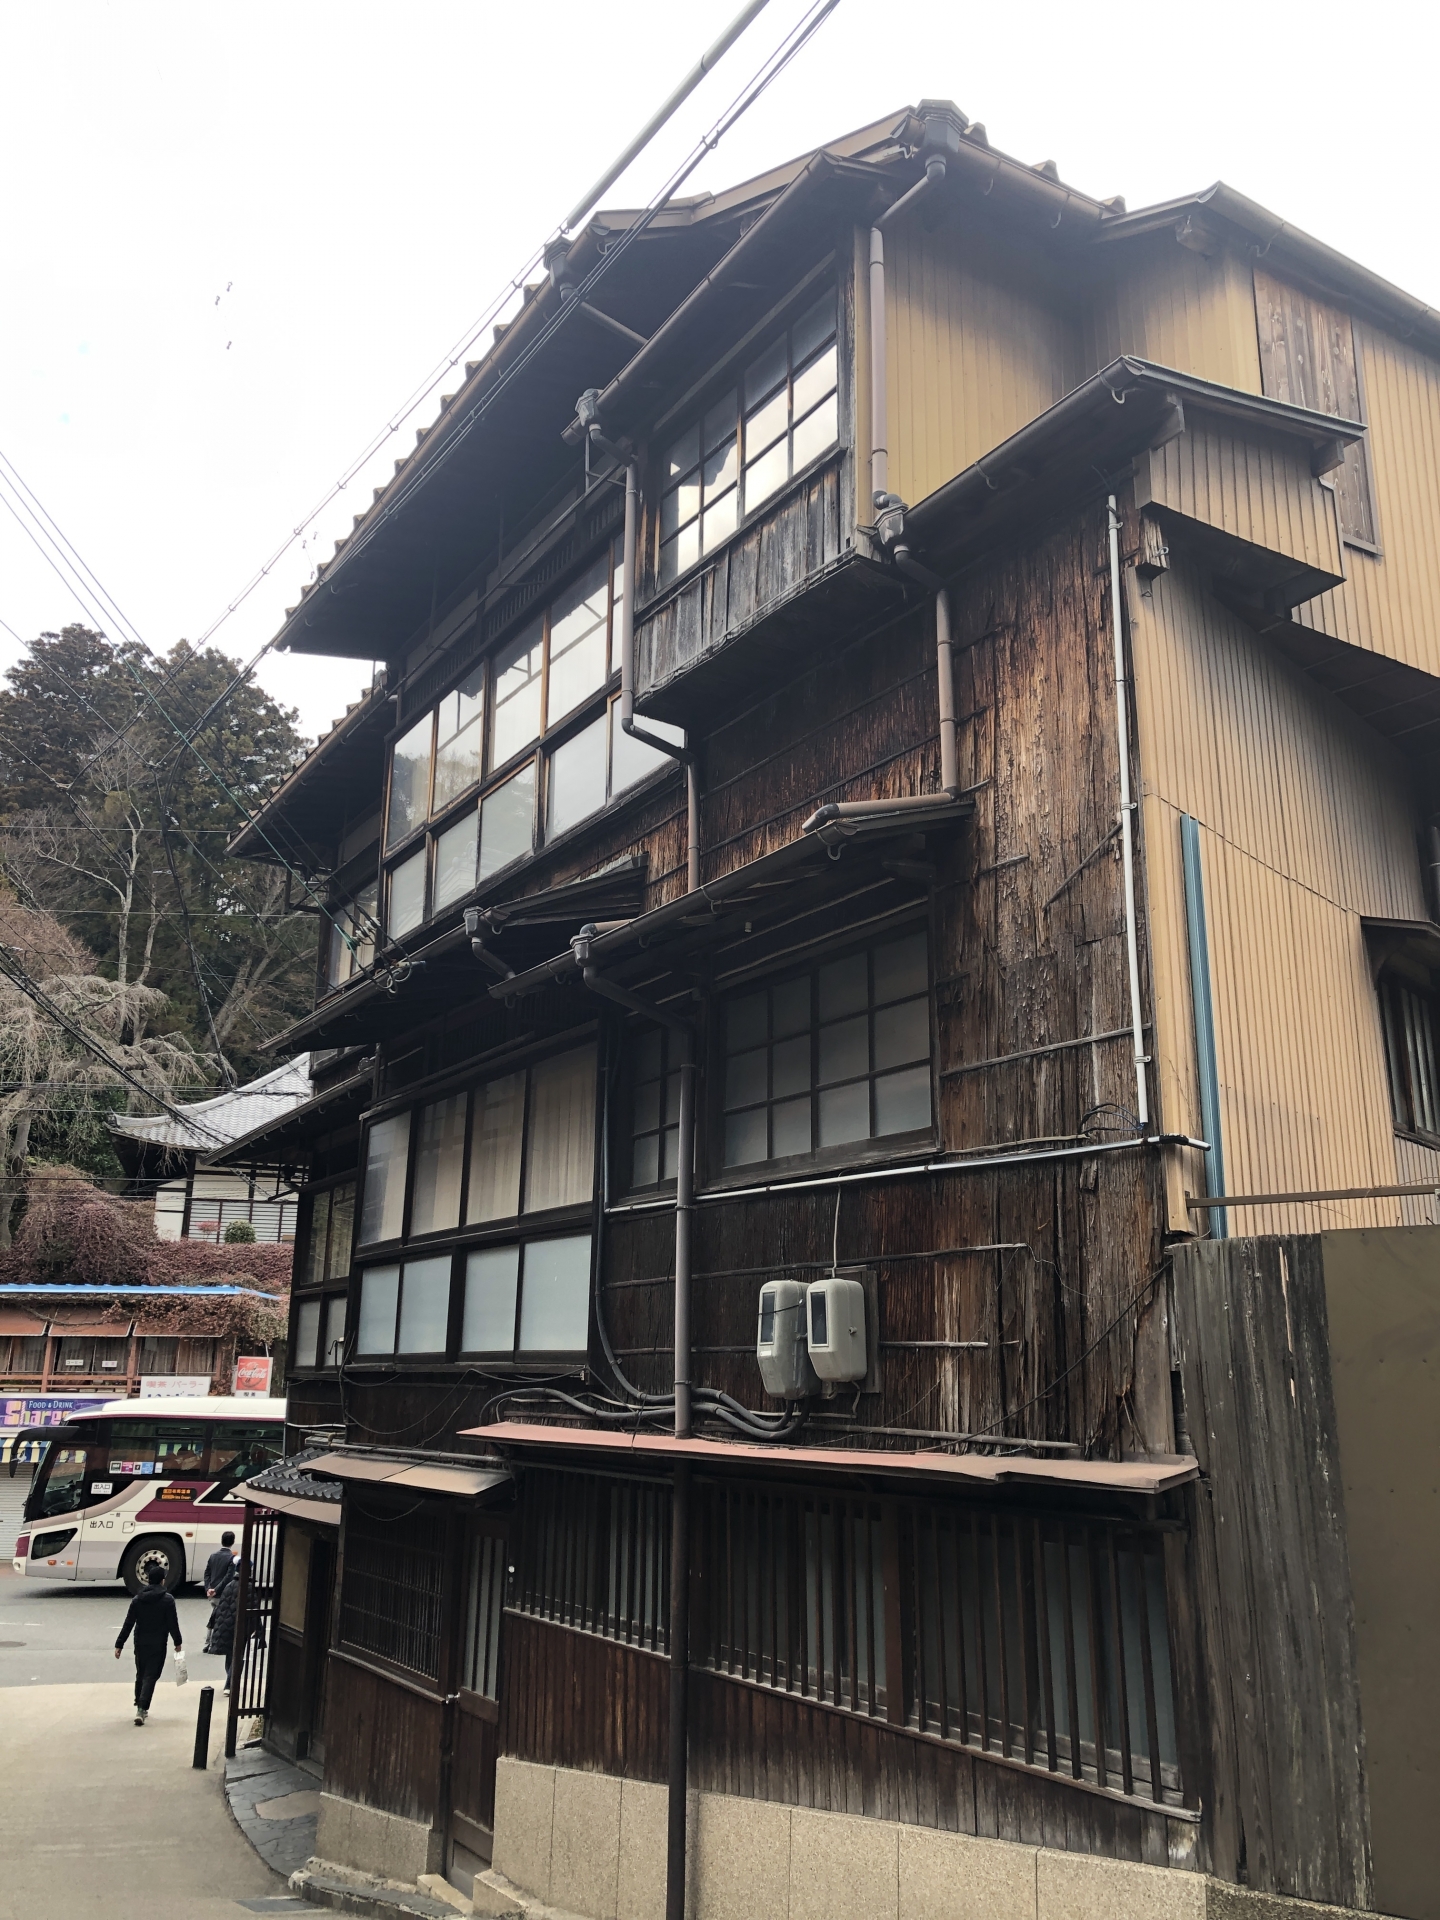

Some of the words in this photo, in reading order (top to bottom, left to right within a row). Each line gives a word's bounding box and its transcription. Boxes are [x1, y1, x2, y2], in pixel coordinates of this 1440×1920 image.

[28, 1400, 47, 1409] FOOD
[53, 1400, 74, 1409] DRINK
[89, 1520, 114, 1528] 出入口
